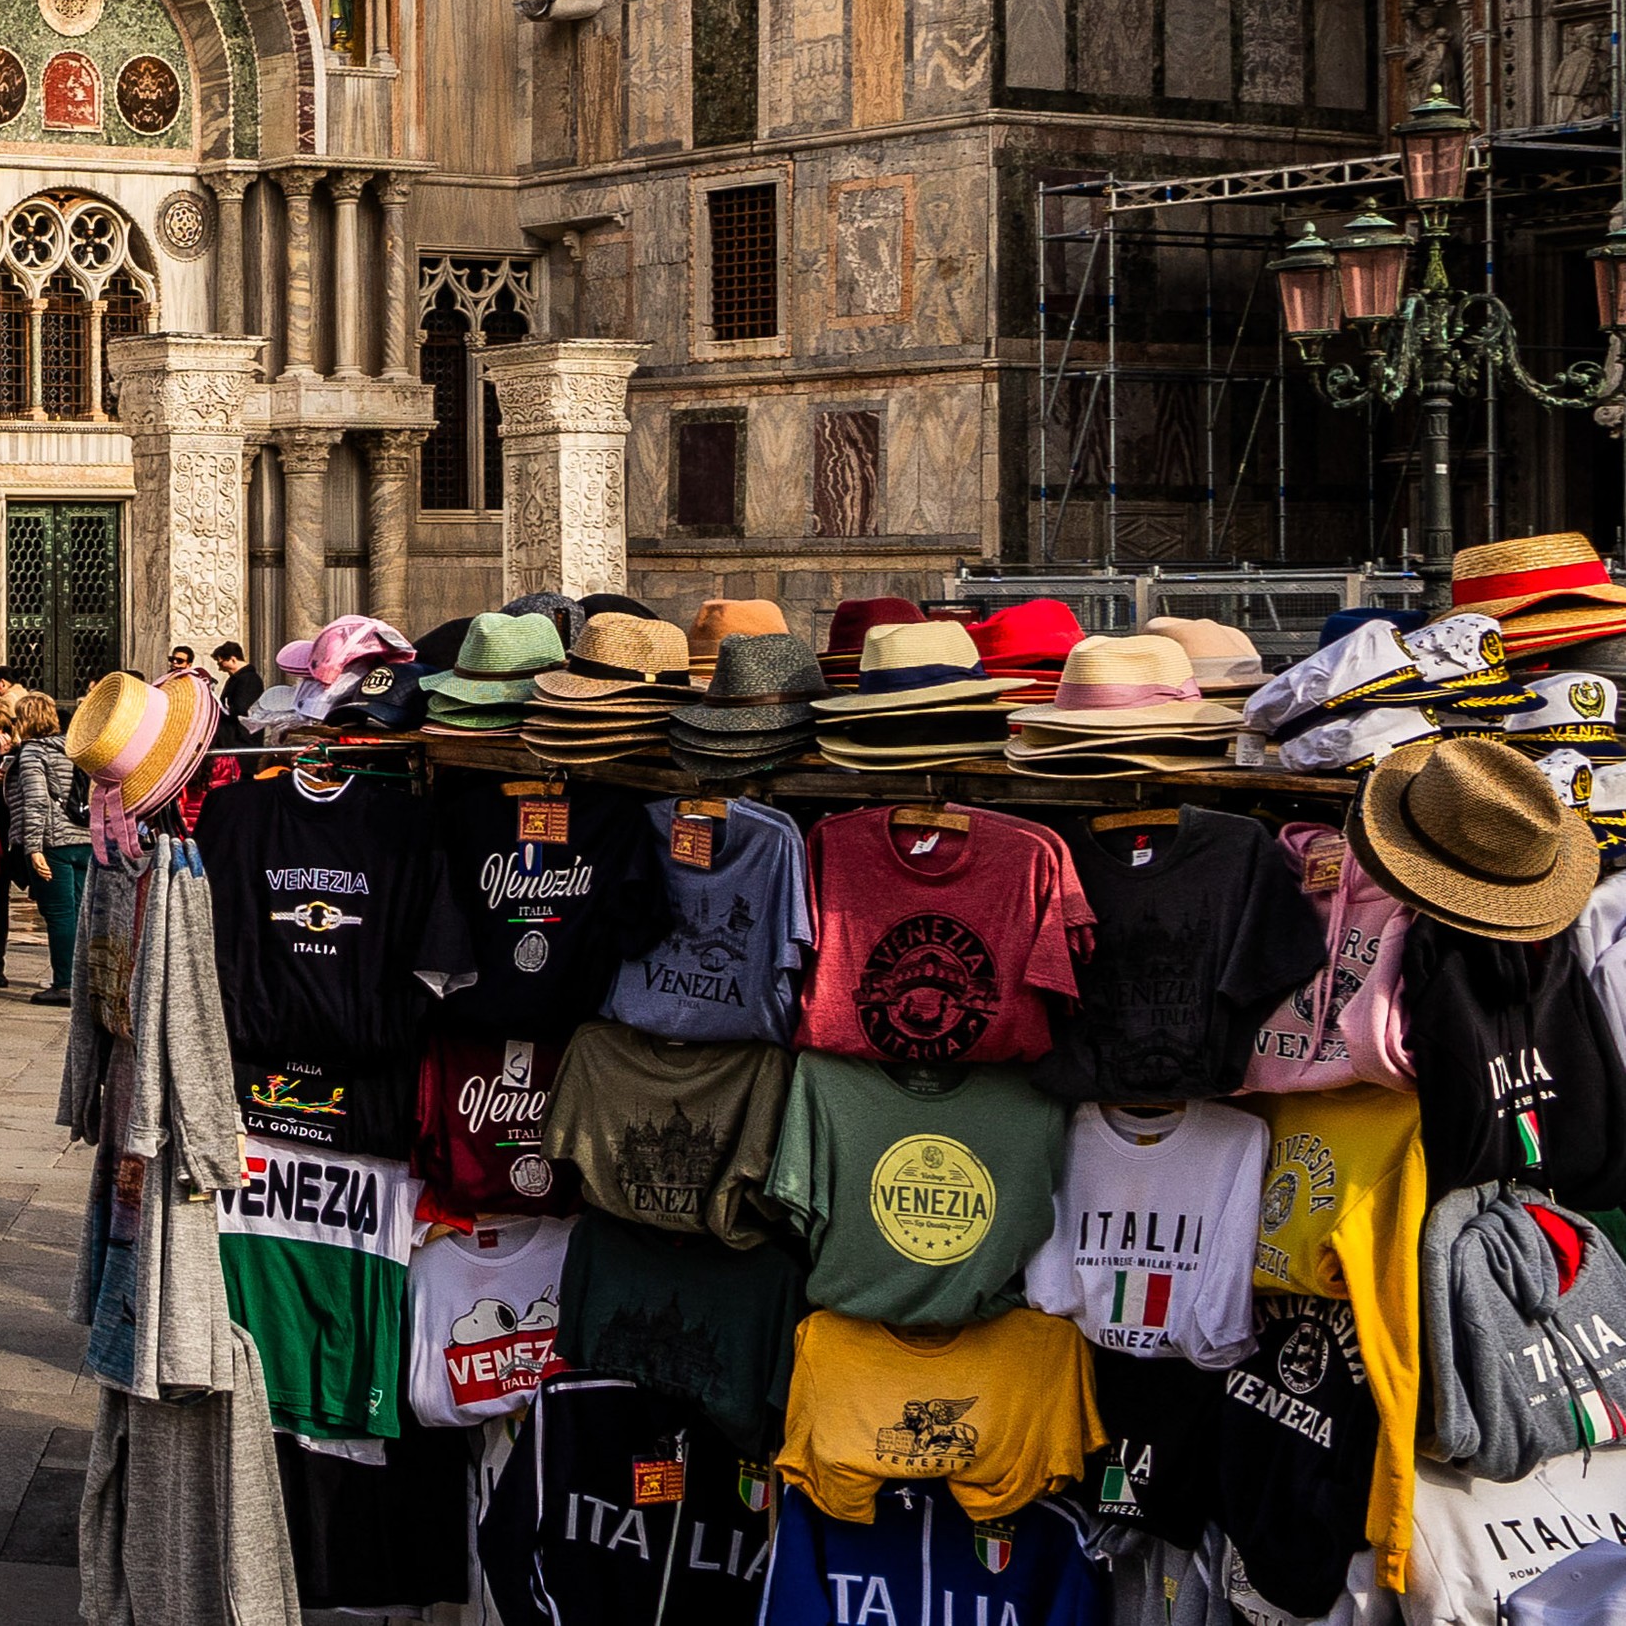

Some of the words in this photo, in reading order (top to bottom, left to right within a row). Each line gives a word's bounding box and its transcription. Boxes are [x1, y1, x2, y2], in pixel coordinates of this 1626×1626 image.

[265, 868, 369, 894] VENEZIA
[480, 852, 593, 910] Venezia
[518, 905, 554, 917] ITALIA
[293, 942, 338, 955] ITALIA
[874, 918, 985, 974] VENEZIA
[642, 960, 745, 1008] VENEZIA
[881, 1031, 961, 1060] ITALIA
[286, 1061, 323, 1076] ITALIA
[458, 1075, 550, 1133] Vene
[248, 1116, 265, 1130] LA
[270, 1121, 333, 1143] GONDOLA
[879, 1185, 987, 1221] VENEZIA
[502, 1375, 541, 1392] ITALIA
[1227, 1369, 1333, 1449] VENEZIA
[875, 1453, 971, 1468] VENEZIA
[1508, 1566, 1542, 1581] ROMA
